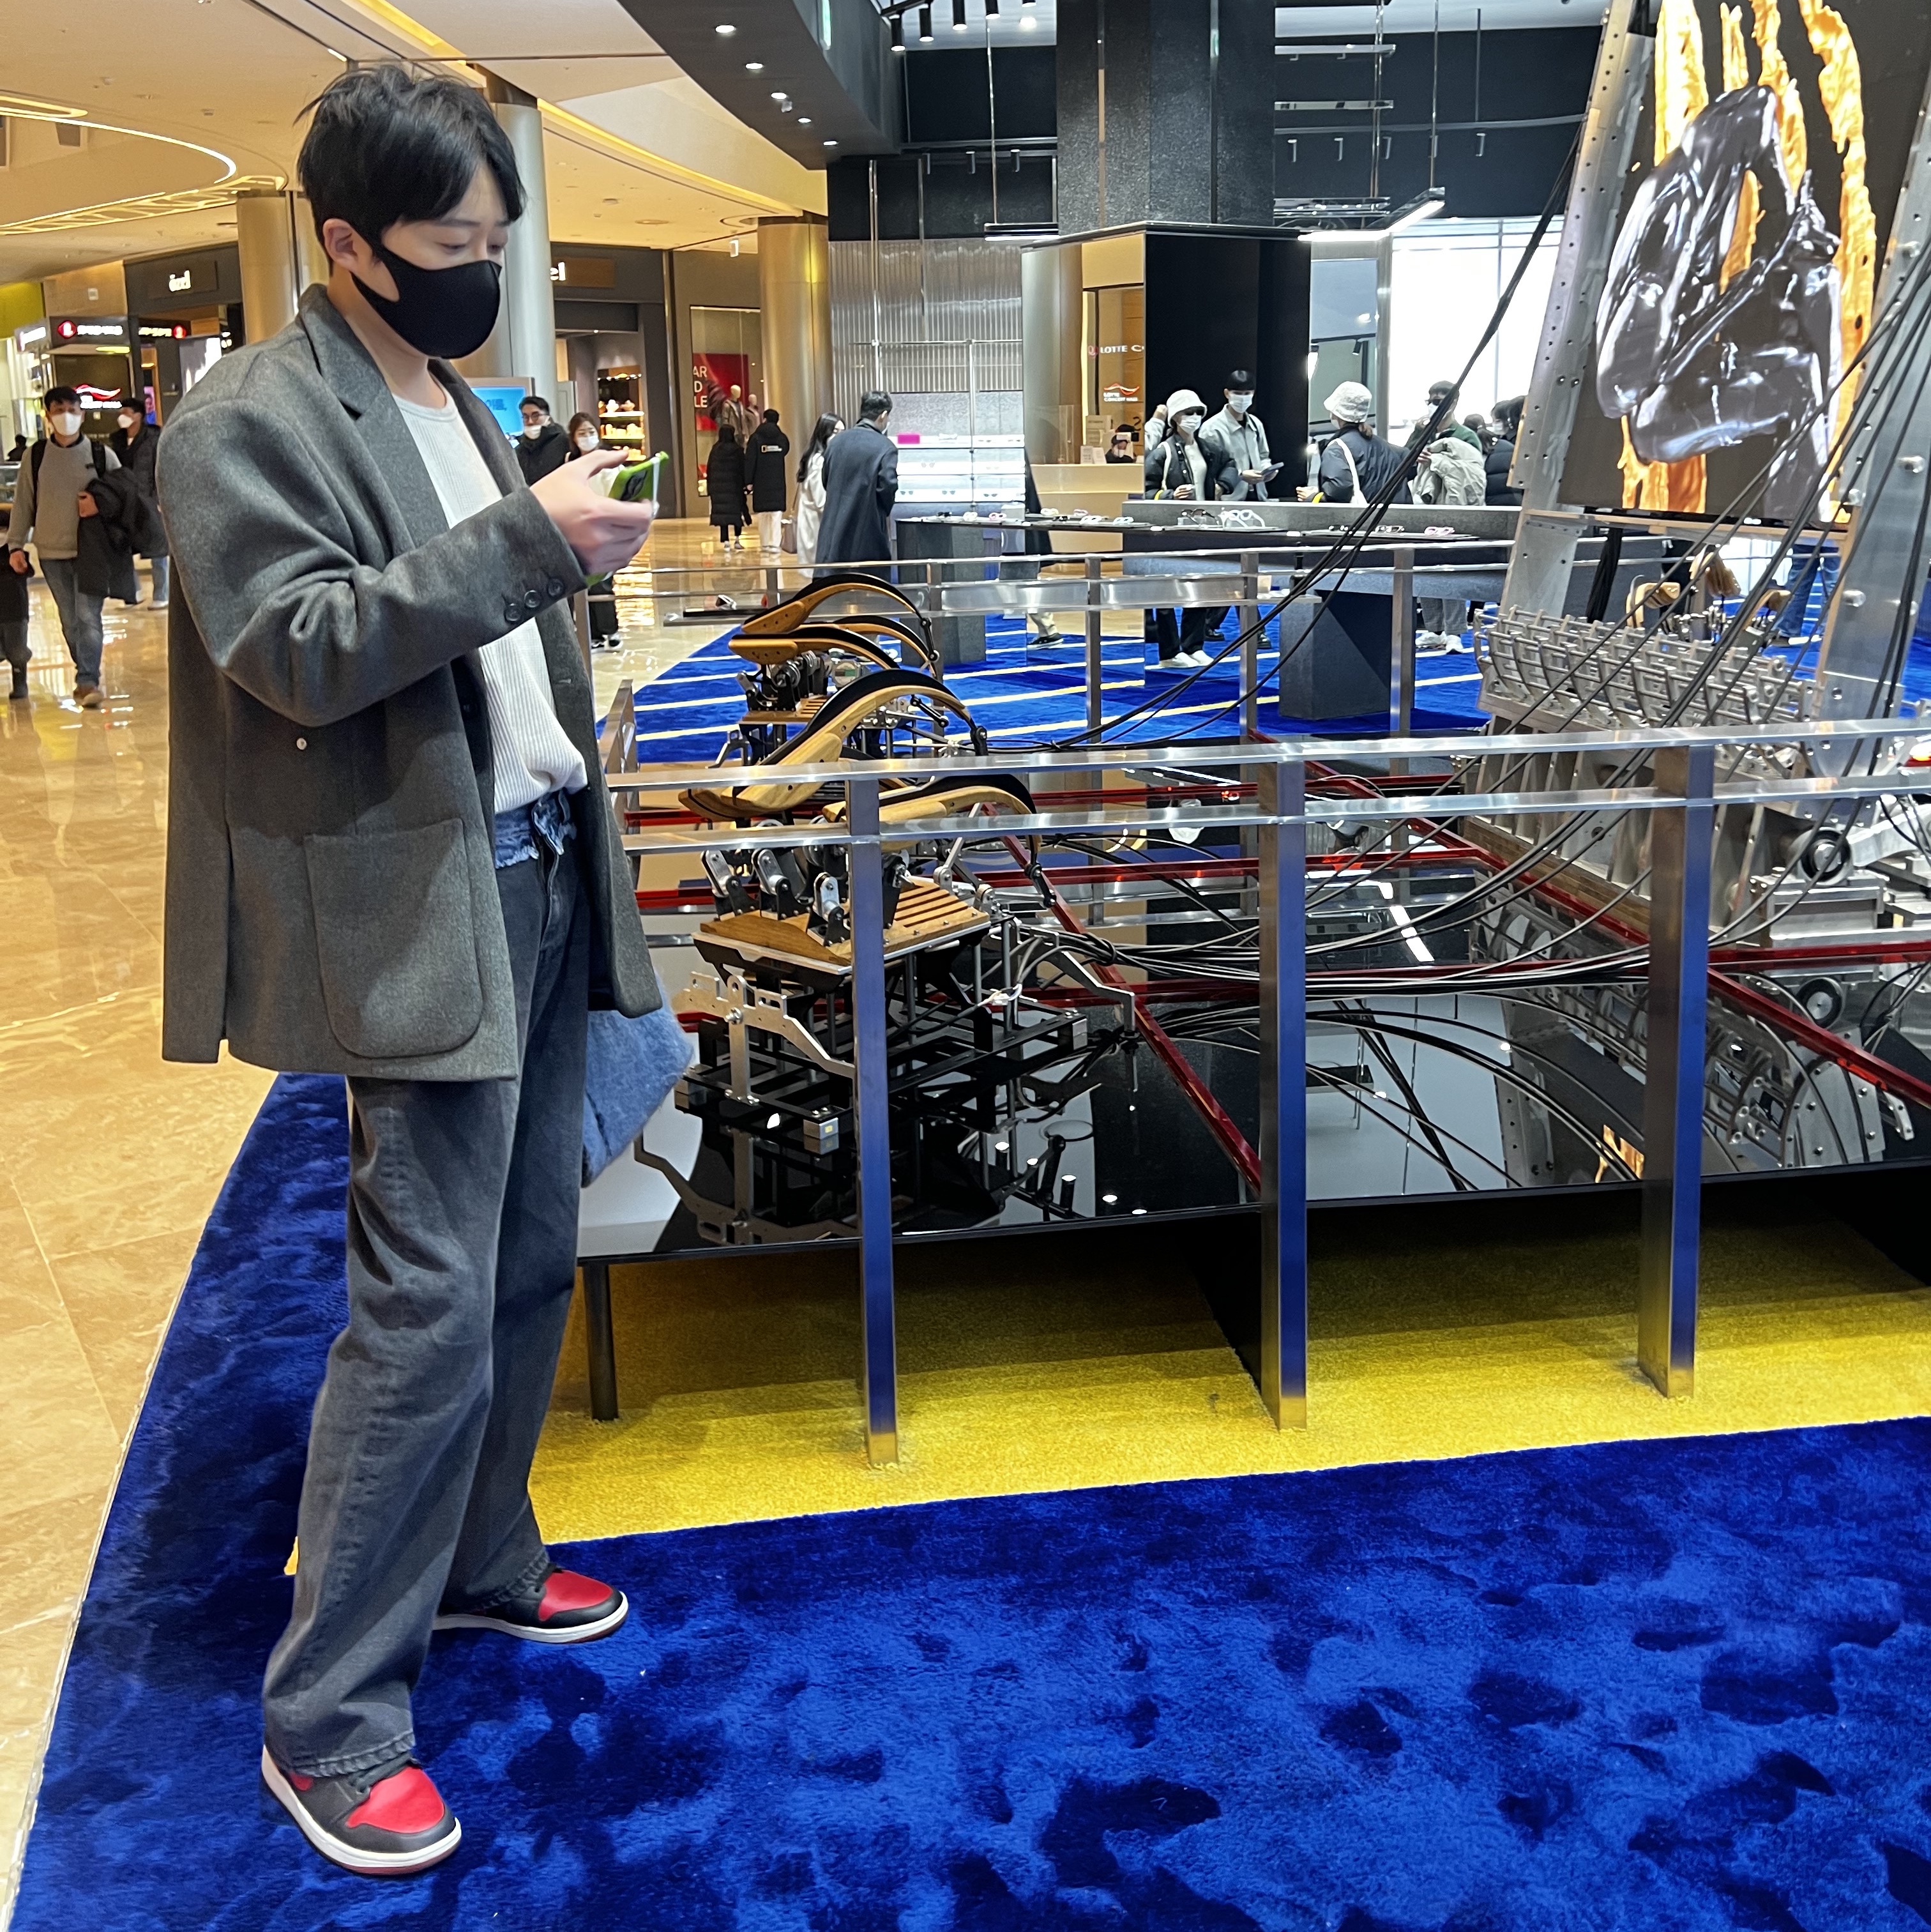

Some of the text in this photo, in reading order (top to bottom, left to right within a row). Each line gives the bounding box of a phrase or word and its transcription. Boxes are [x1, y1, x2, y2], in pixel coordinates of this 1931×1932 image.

[1100, 346, 1128, 354] LOTTE
[693, 365, 708, 377] AR
[694, 381, 703, 393] D
[694, 395, 708, 408] LE
